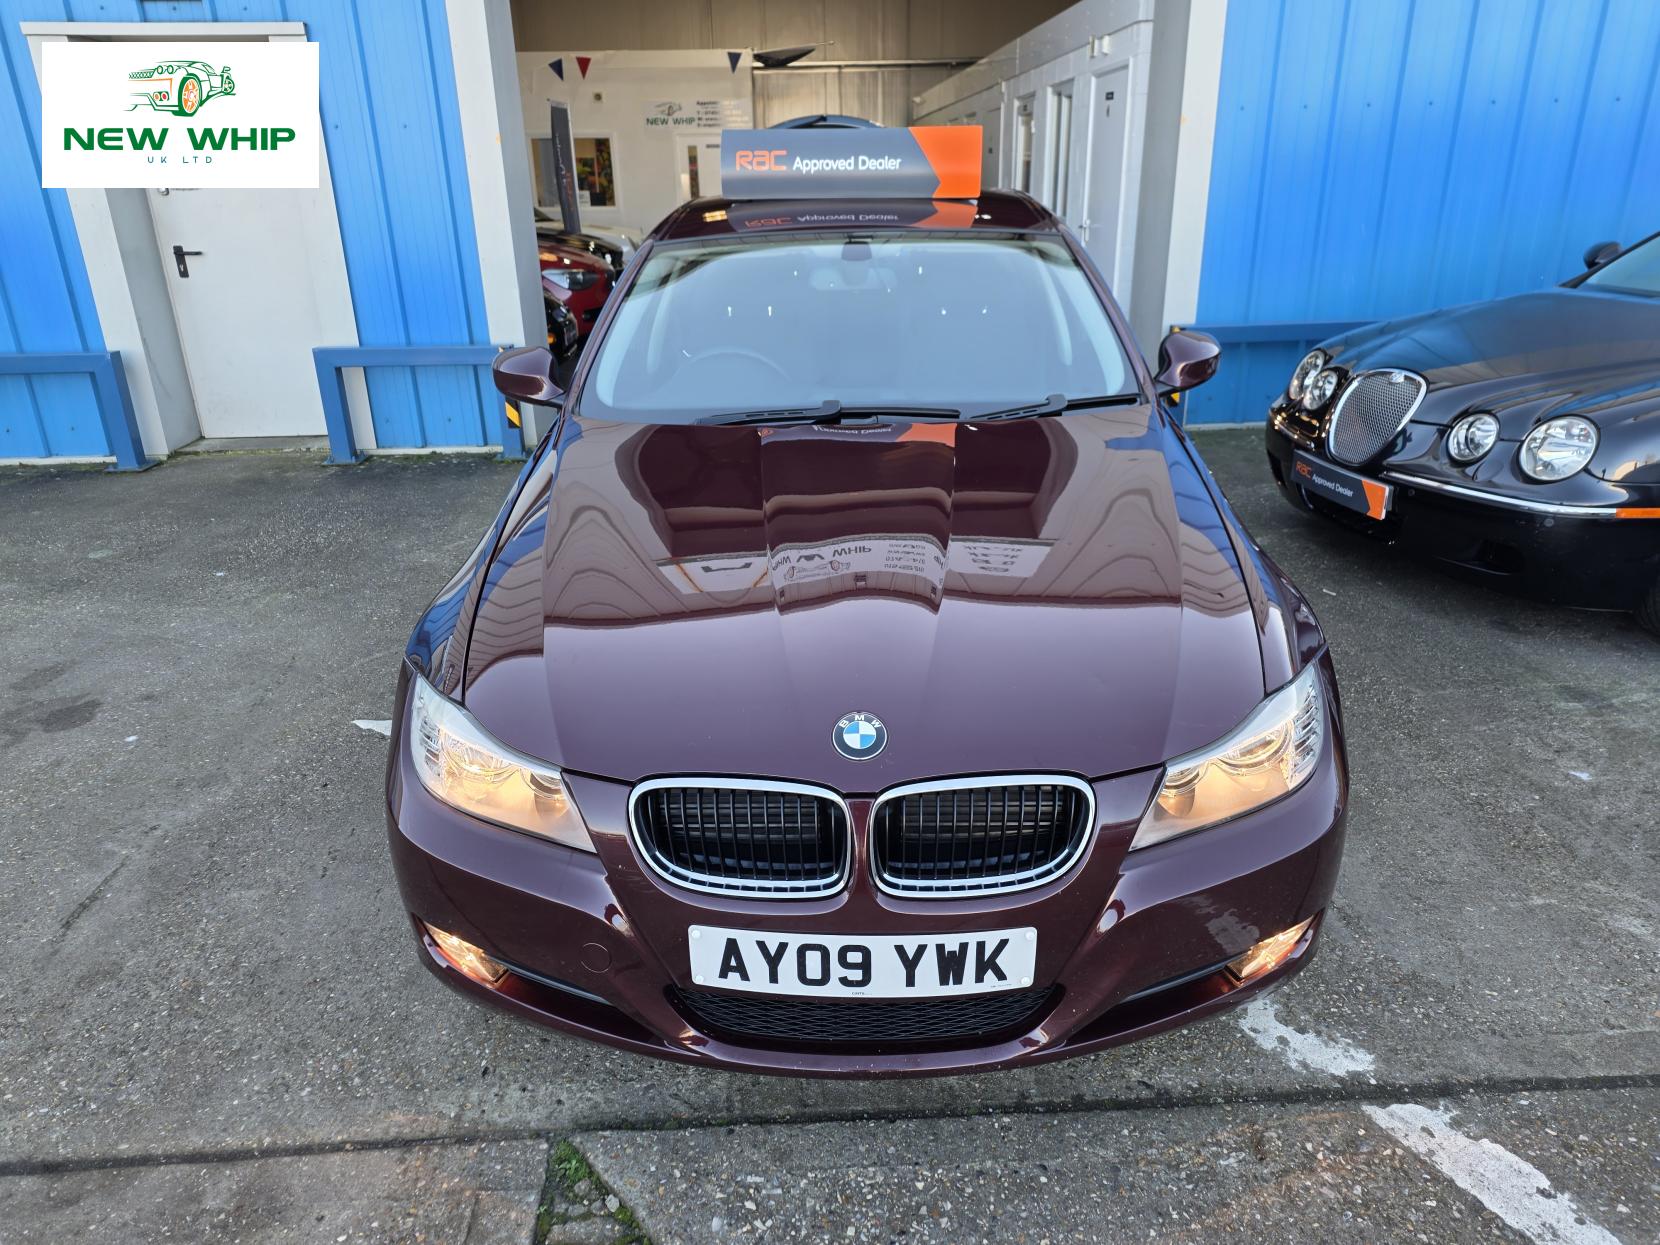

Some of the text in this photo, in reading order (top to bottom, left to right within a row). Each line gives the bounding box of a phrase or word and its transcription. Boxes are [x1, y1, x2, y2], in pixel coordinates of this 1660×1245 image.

[645, 117, 669, 126] NEW
[672, 116, 696, 125] WHIP
[792, 155, 855, 174] Approved
[858, 155, 902, 171] Dealer
[1312, 474, 1336, 491] Approved
[1335, 483, 1354, 498] Dealer
[838, 714, 882, 728] BMW
[718, 938, 1010, 988] AY09 YWK
